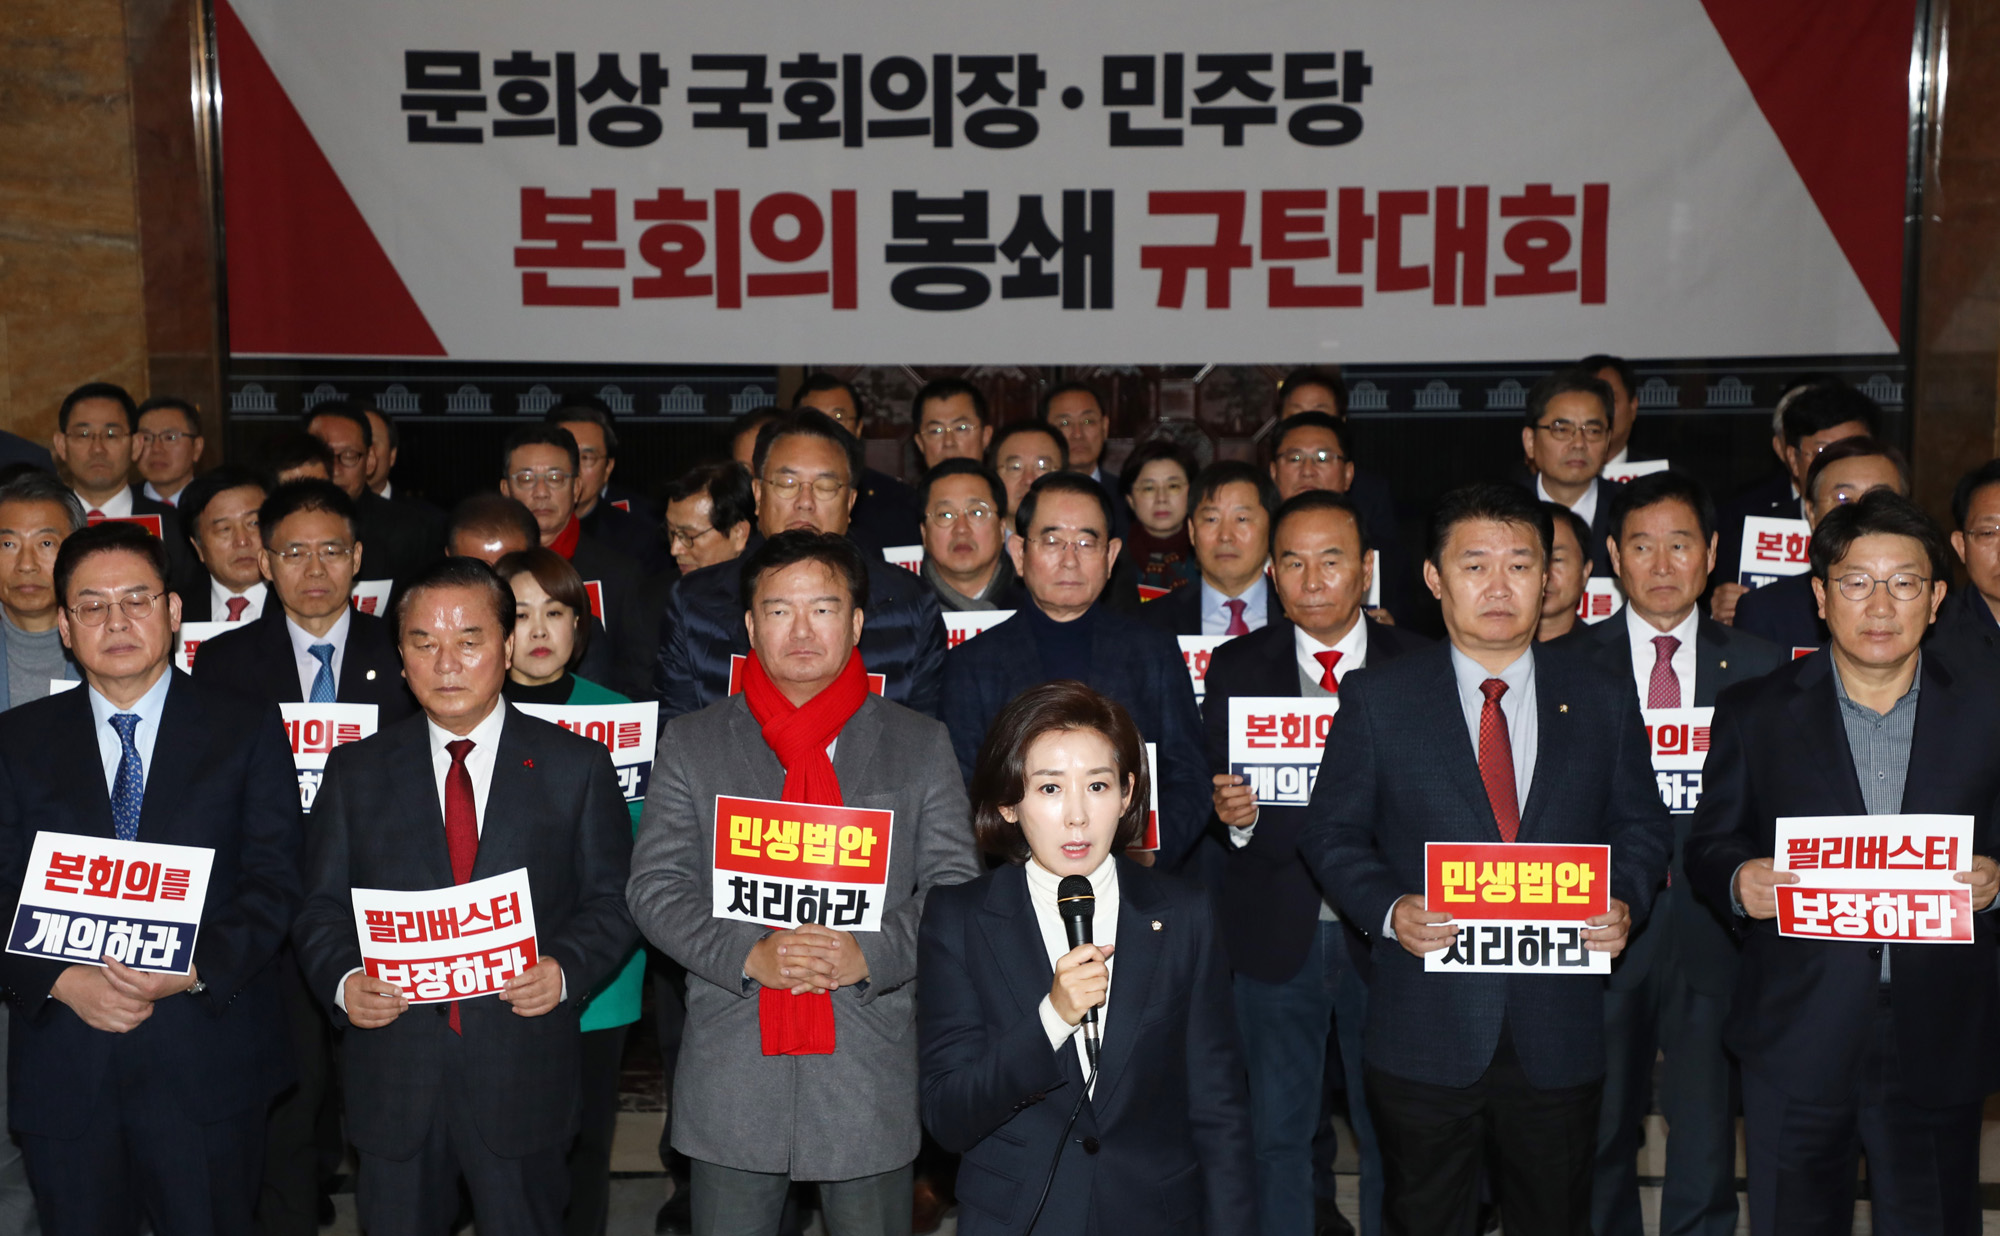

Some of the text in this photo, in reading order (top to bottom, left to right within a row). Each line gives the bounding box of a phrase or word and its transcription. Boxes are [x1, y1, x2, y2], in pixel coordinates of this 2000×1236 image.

[401, 50, 669, 148] 문희상
[514, 183, 1610, 311] 본회의 봉쇄 규탄대회
[1649, 724, 1711, 755] 의를
[1242, 765, 1320, 800] 개의
[729, 815, 877, 867] 민생법안
[1786, 835, 1958, 871] 필리버스터
[44, 851, 191, 902] 본회의를
[727, 876, 870, 927] 처리하라
[1441, 861, 1595, 905] 민생법안
[24, 911, 182, 968] 개의하라
[365, 892, 522, 944] 필리버스터
[1791, 891, 1957, 939] 보장하라
